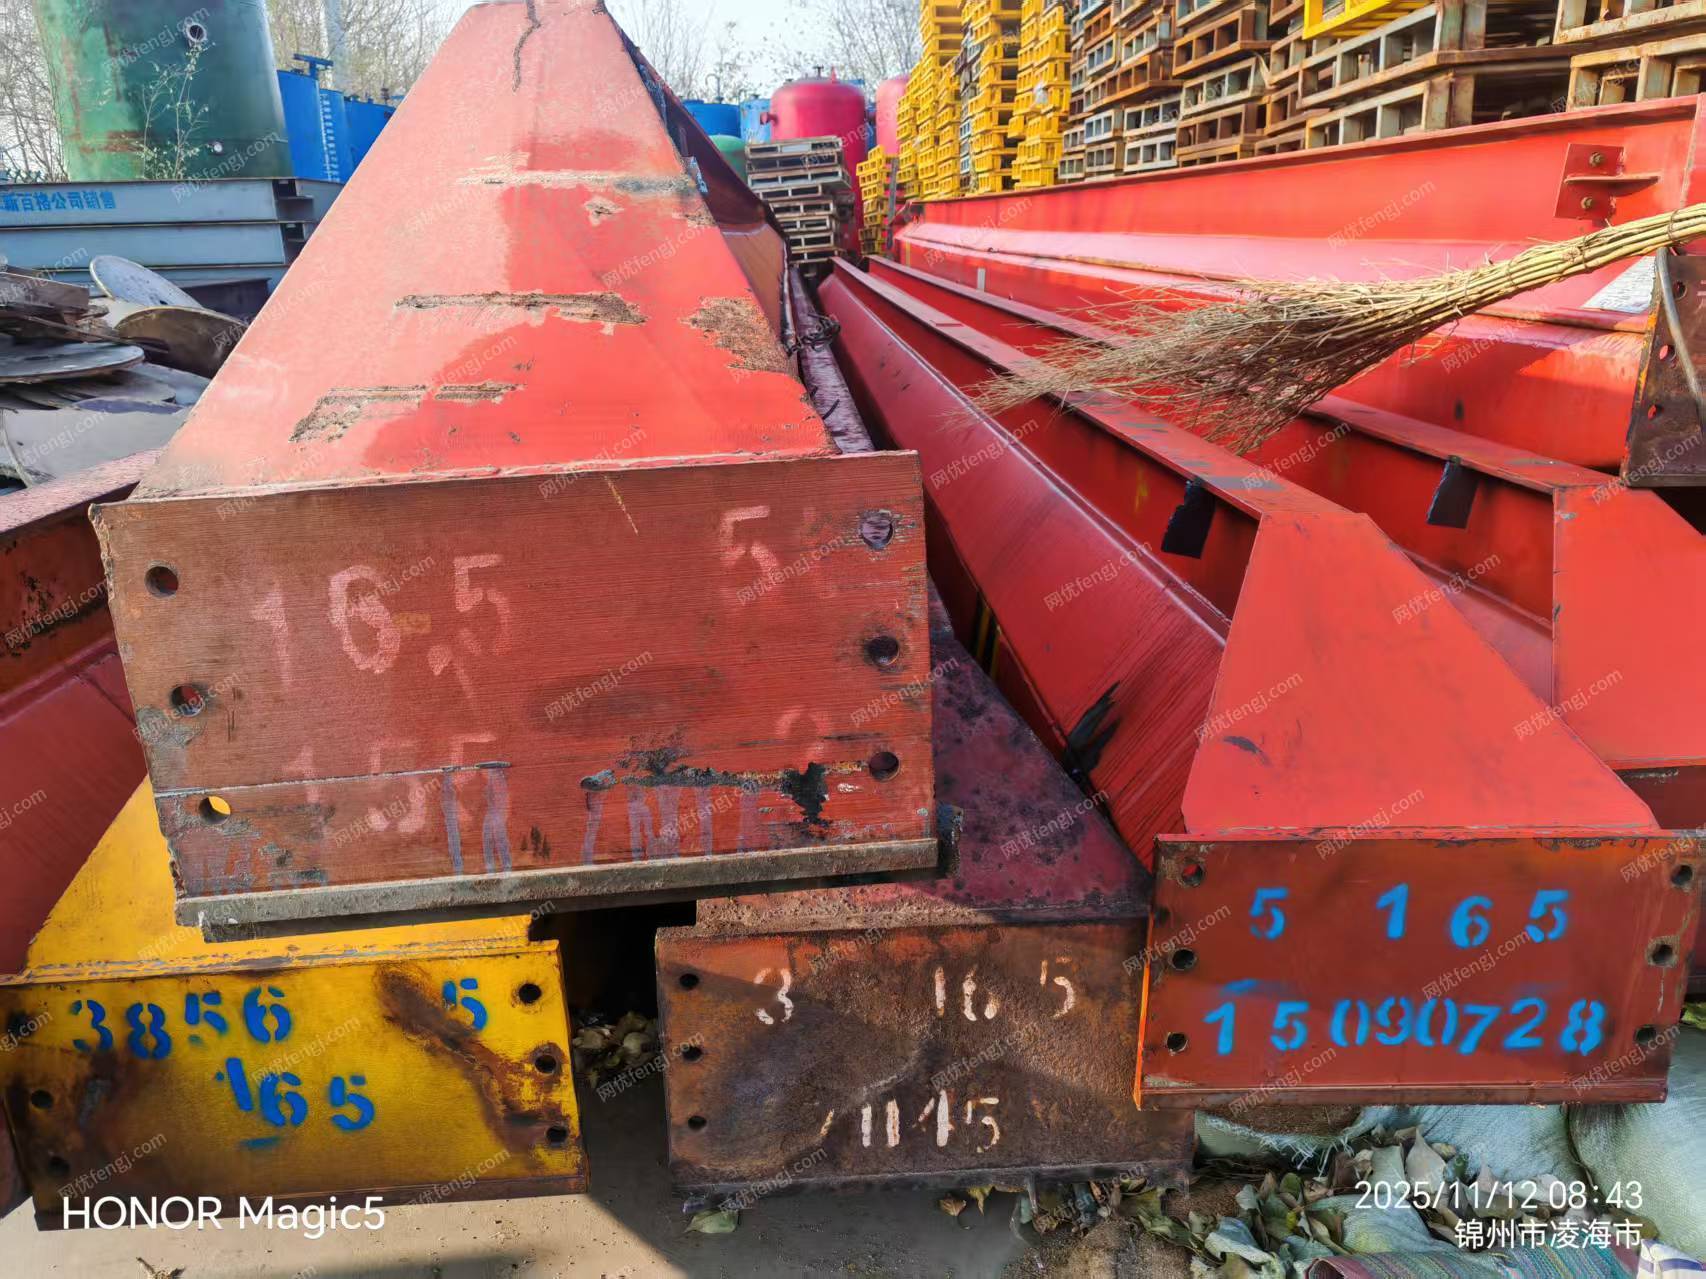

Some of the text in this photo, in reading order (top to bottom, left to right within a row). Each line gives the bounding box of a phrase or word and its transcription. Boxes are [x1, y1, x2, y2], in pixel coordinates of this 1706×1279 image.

[1249, 886, 1289, 940] 5
[442, 977, 488, 1032] 5
[753, 967, 794, 1024] 3
